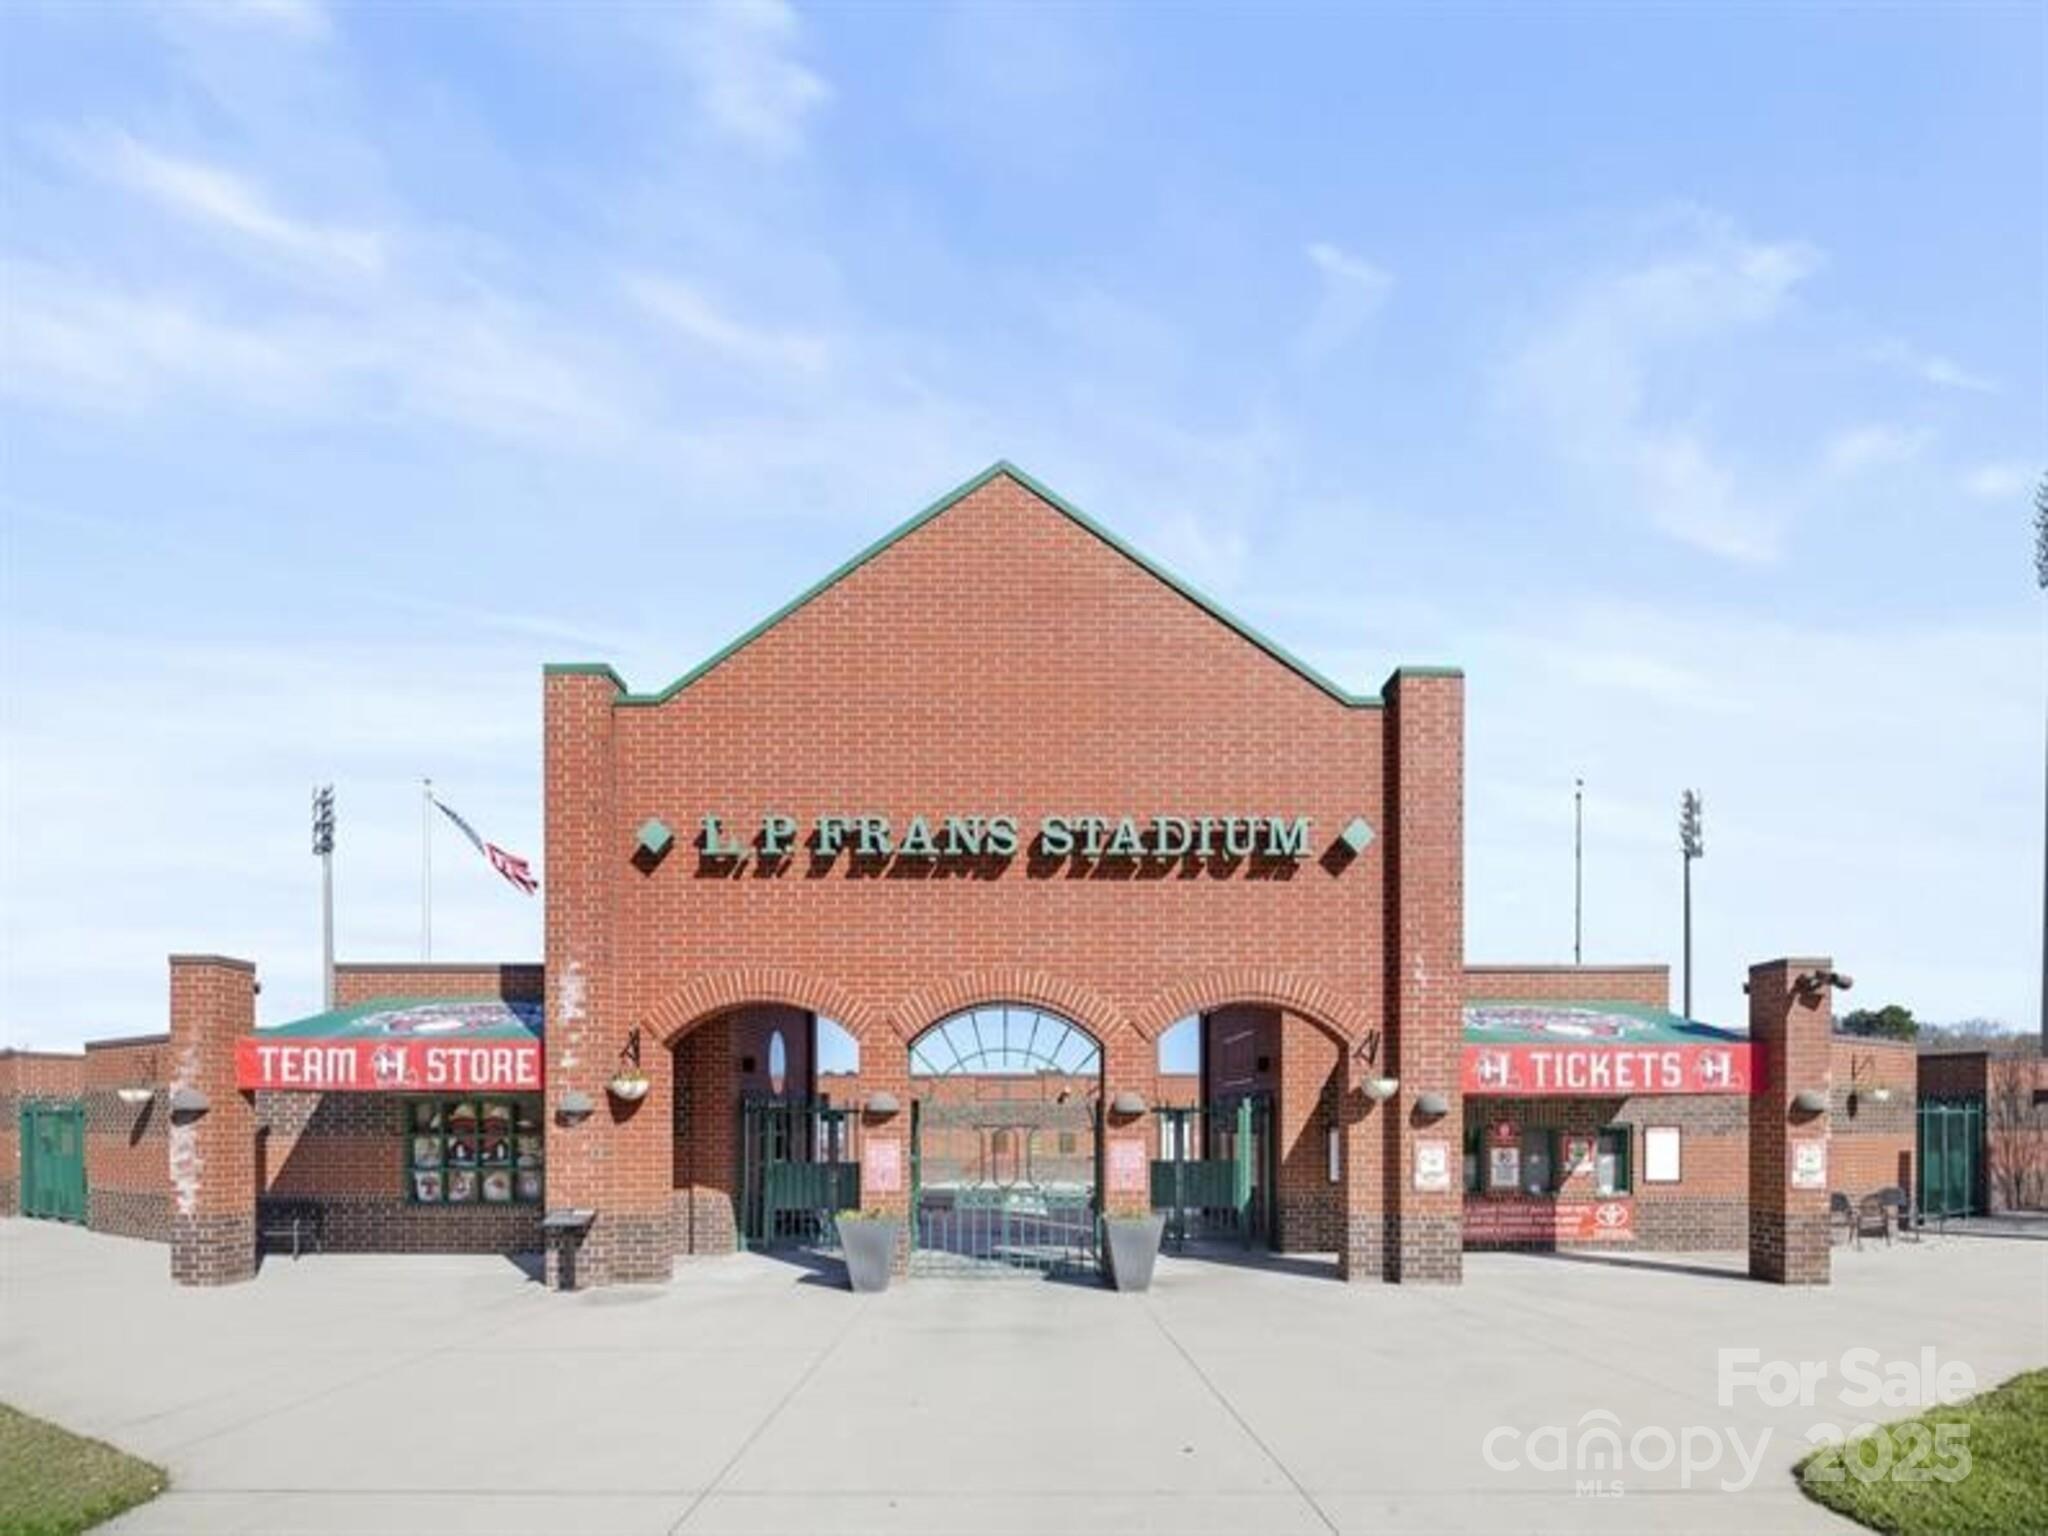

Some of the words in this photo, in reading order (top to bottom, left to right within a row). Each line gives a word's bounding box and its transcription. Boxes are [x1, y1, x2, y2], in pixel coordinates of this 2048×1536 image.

[814, 814, 1020, 857] FRANS
[1040, 814, 1314, 857] STADIUM
[256, 1046, 357, 1083] TEAM
[426, 1047, 538, 1083] STORE
[1529, 1051, 1683, 1089] TICKETS
